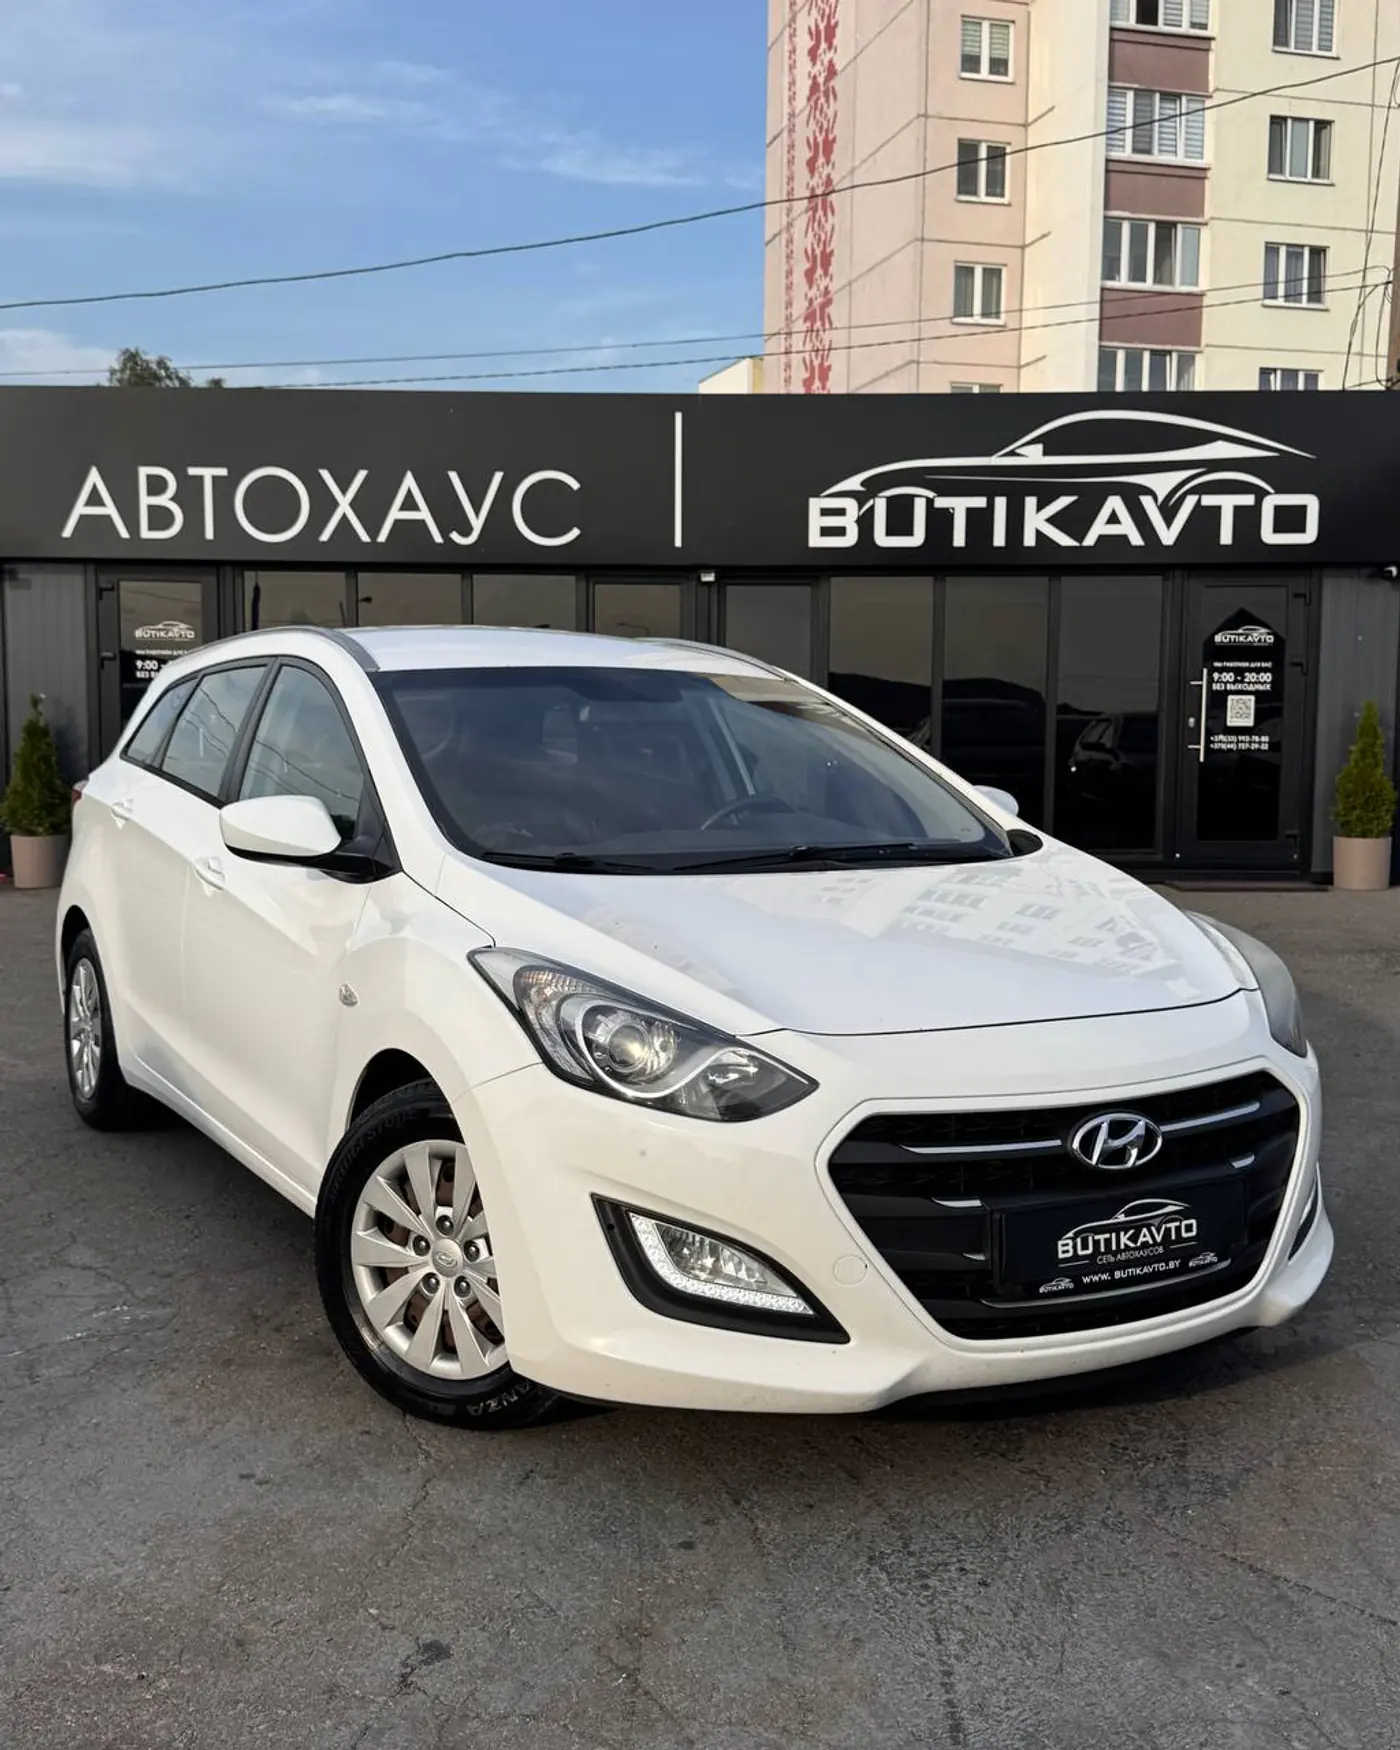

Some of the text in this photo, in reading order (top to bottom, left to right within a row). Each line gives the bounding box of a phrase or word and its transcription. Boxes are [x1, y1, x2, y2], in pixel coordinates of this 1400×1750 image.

[62, 466, 581, 546] АВТОХАУС
[808, 493, 1320, 548] BUTIKAVTO
[134, 629, 195, 639] BUTIKAVTO
[1214, 634, 1274, 643] BUTIKAVTO
[136, 661, 159, 671] 9:00
[1212, 672, 1235, 682] 9:00
[1244, 672, 1273, 683] 20:00
[1226, 683, 1272, 692] ВЫХОДНЫХ
[1057, 1218, 1198, 1259] BUTIKAVTO
[1097, 1247, 1164, 1265] СЕТЬ АВТОХАУСОВ
[1081, 1259, 1182, 1285] WWW. BUTIKAVTO.BY
[1038, 1282, 1074, 1294] BUTIKAVTO
